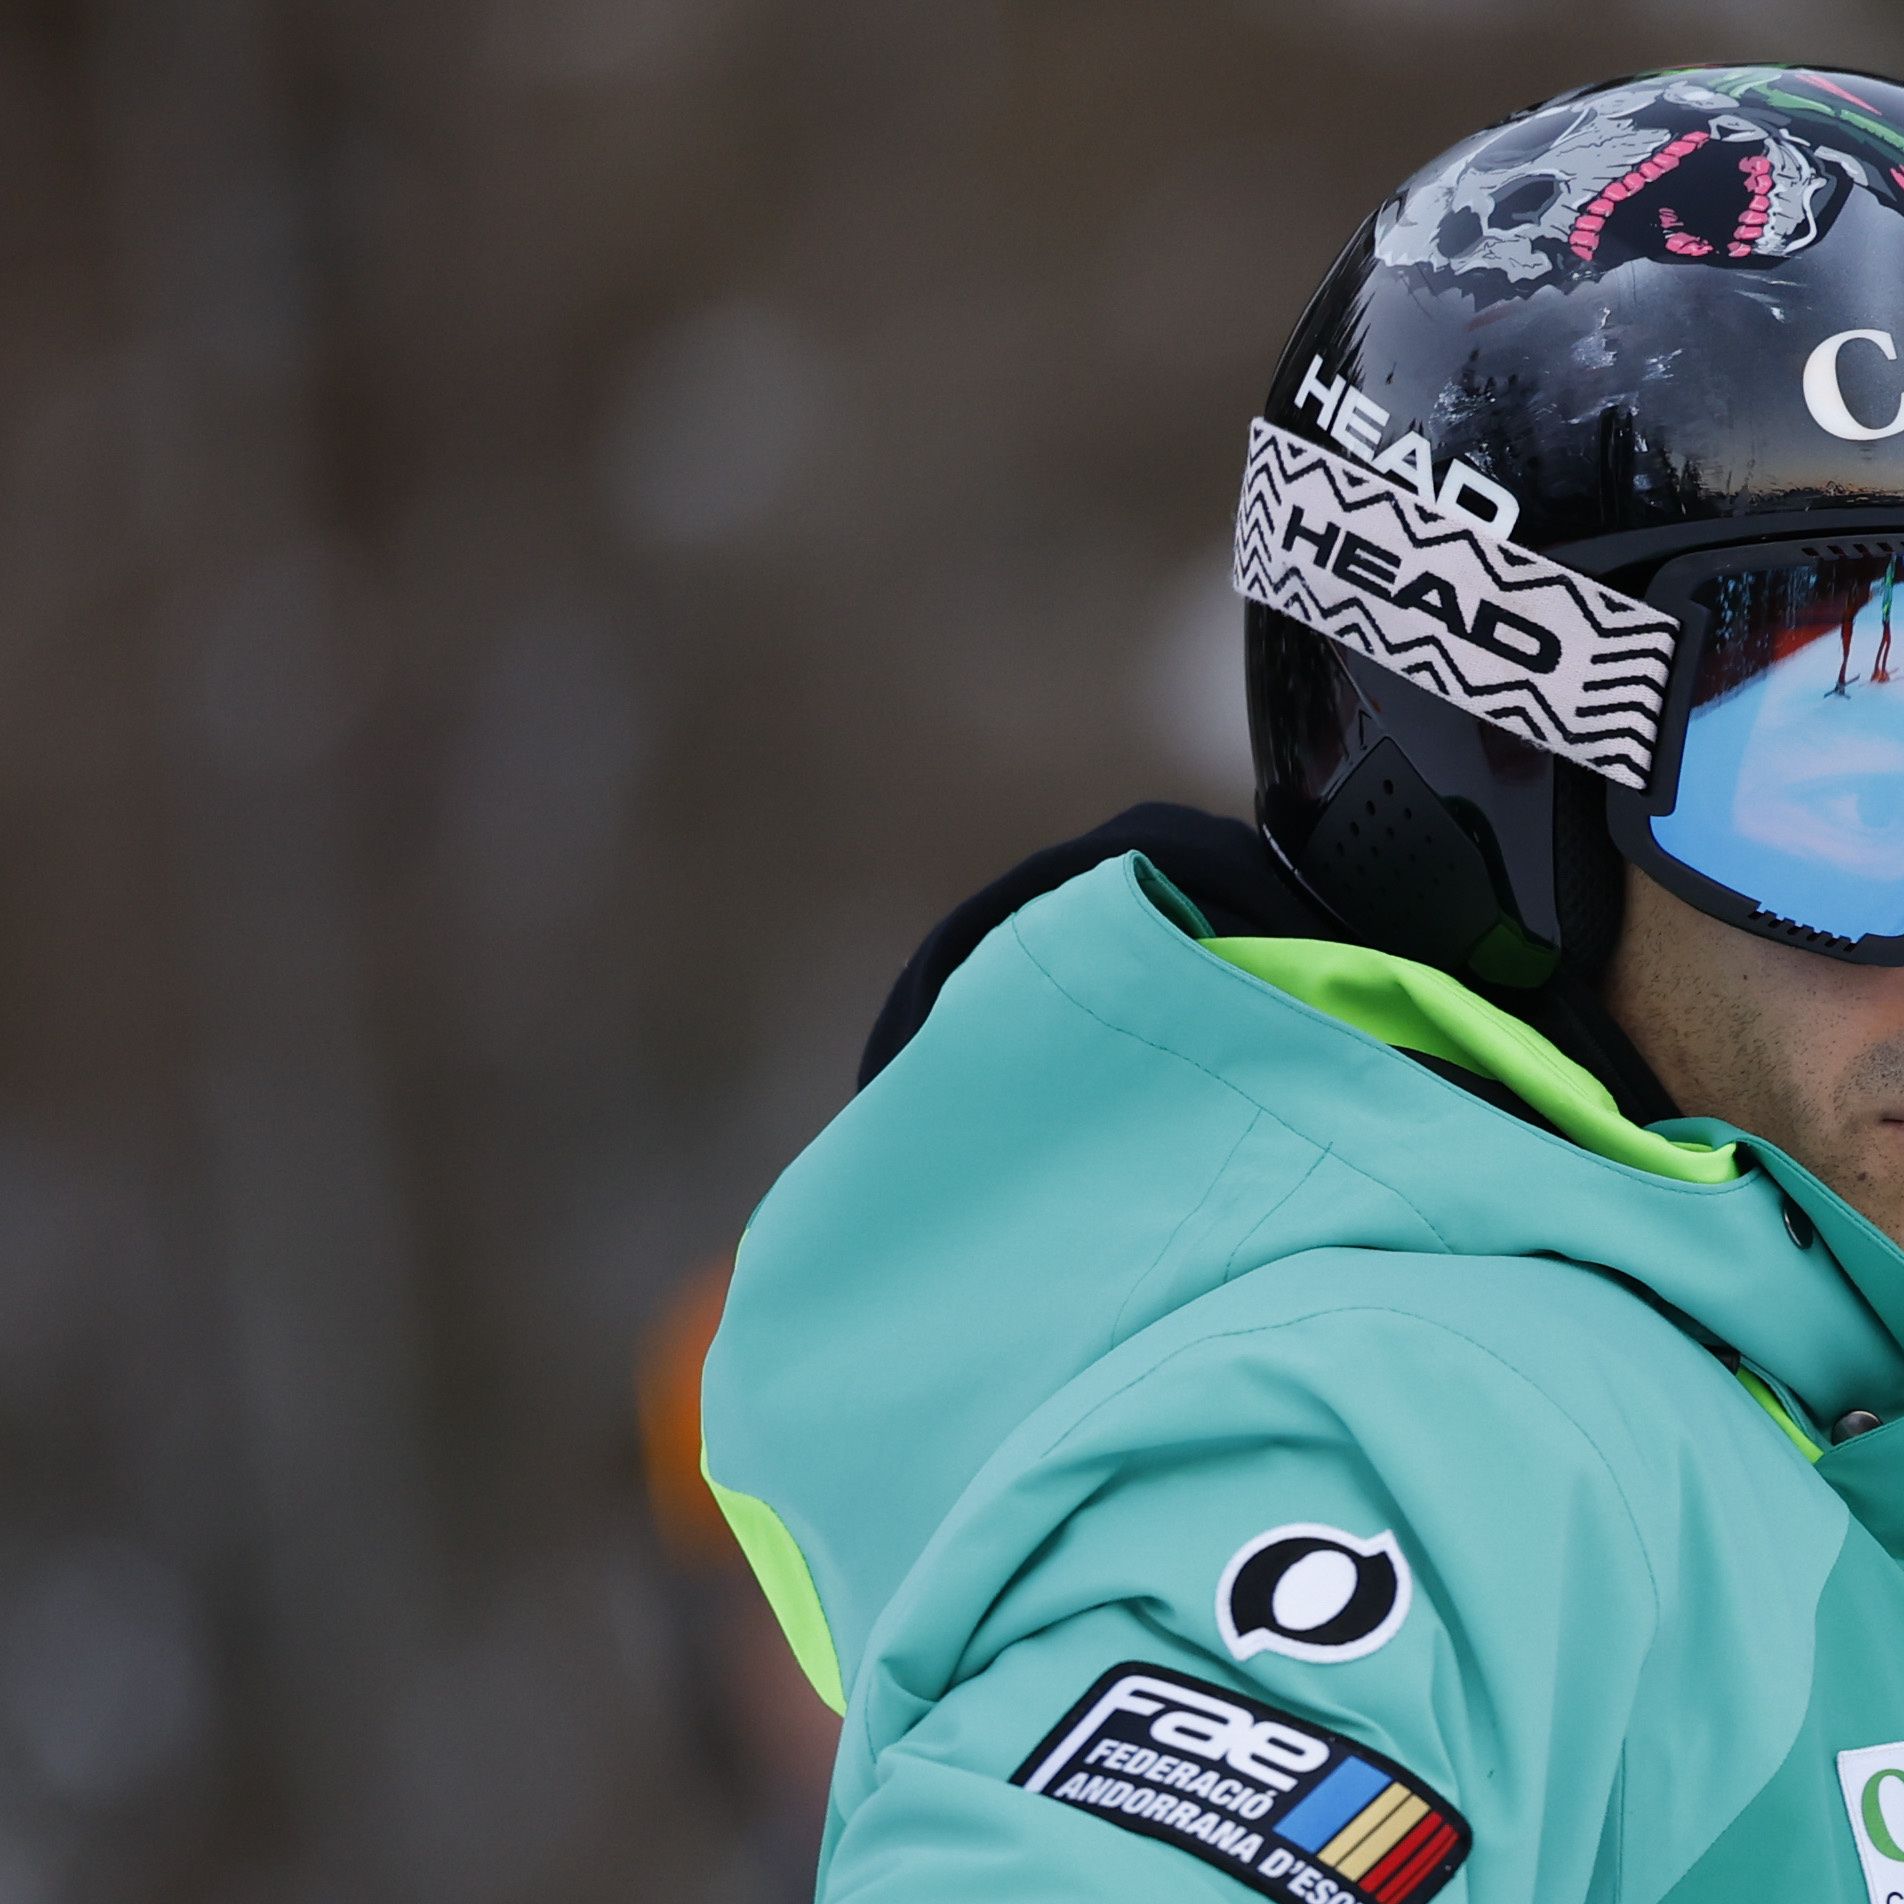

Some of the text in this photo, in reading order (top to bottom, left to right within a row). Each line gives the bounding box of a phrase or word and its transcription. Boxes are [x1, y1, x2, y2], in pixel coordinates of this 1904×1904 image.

[1293, 354, 1520, 541] HEAD
[1281, 504, 1563, 674] HEAD
[1053, 1771, 1265, 1865] ANDORRANA
[1084, 1738, 1279, 1821] FEDERACIÓ
